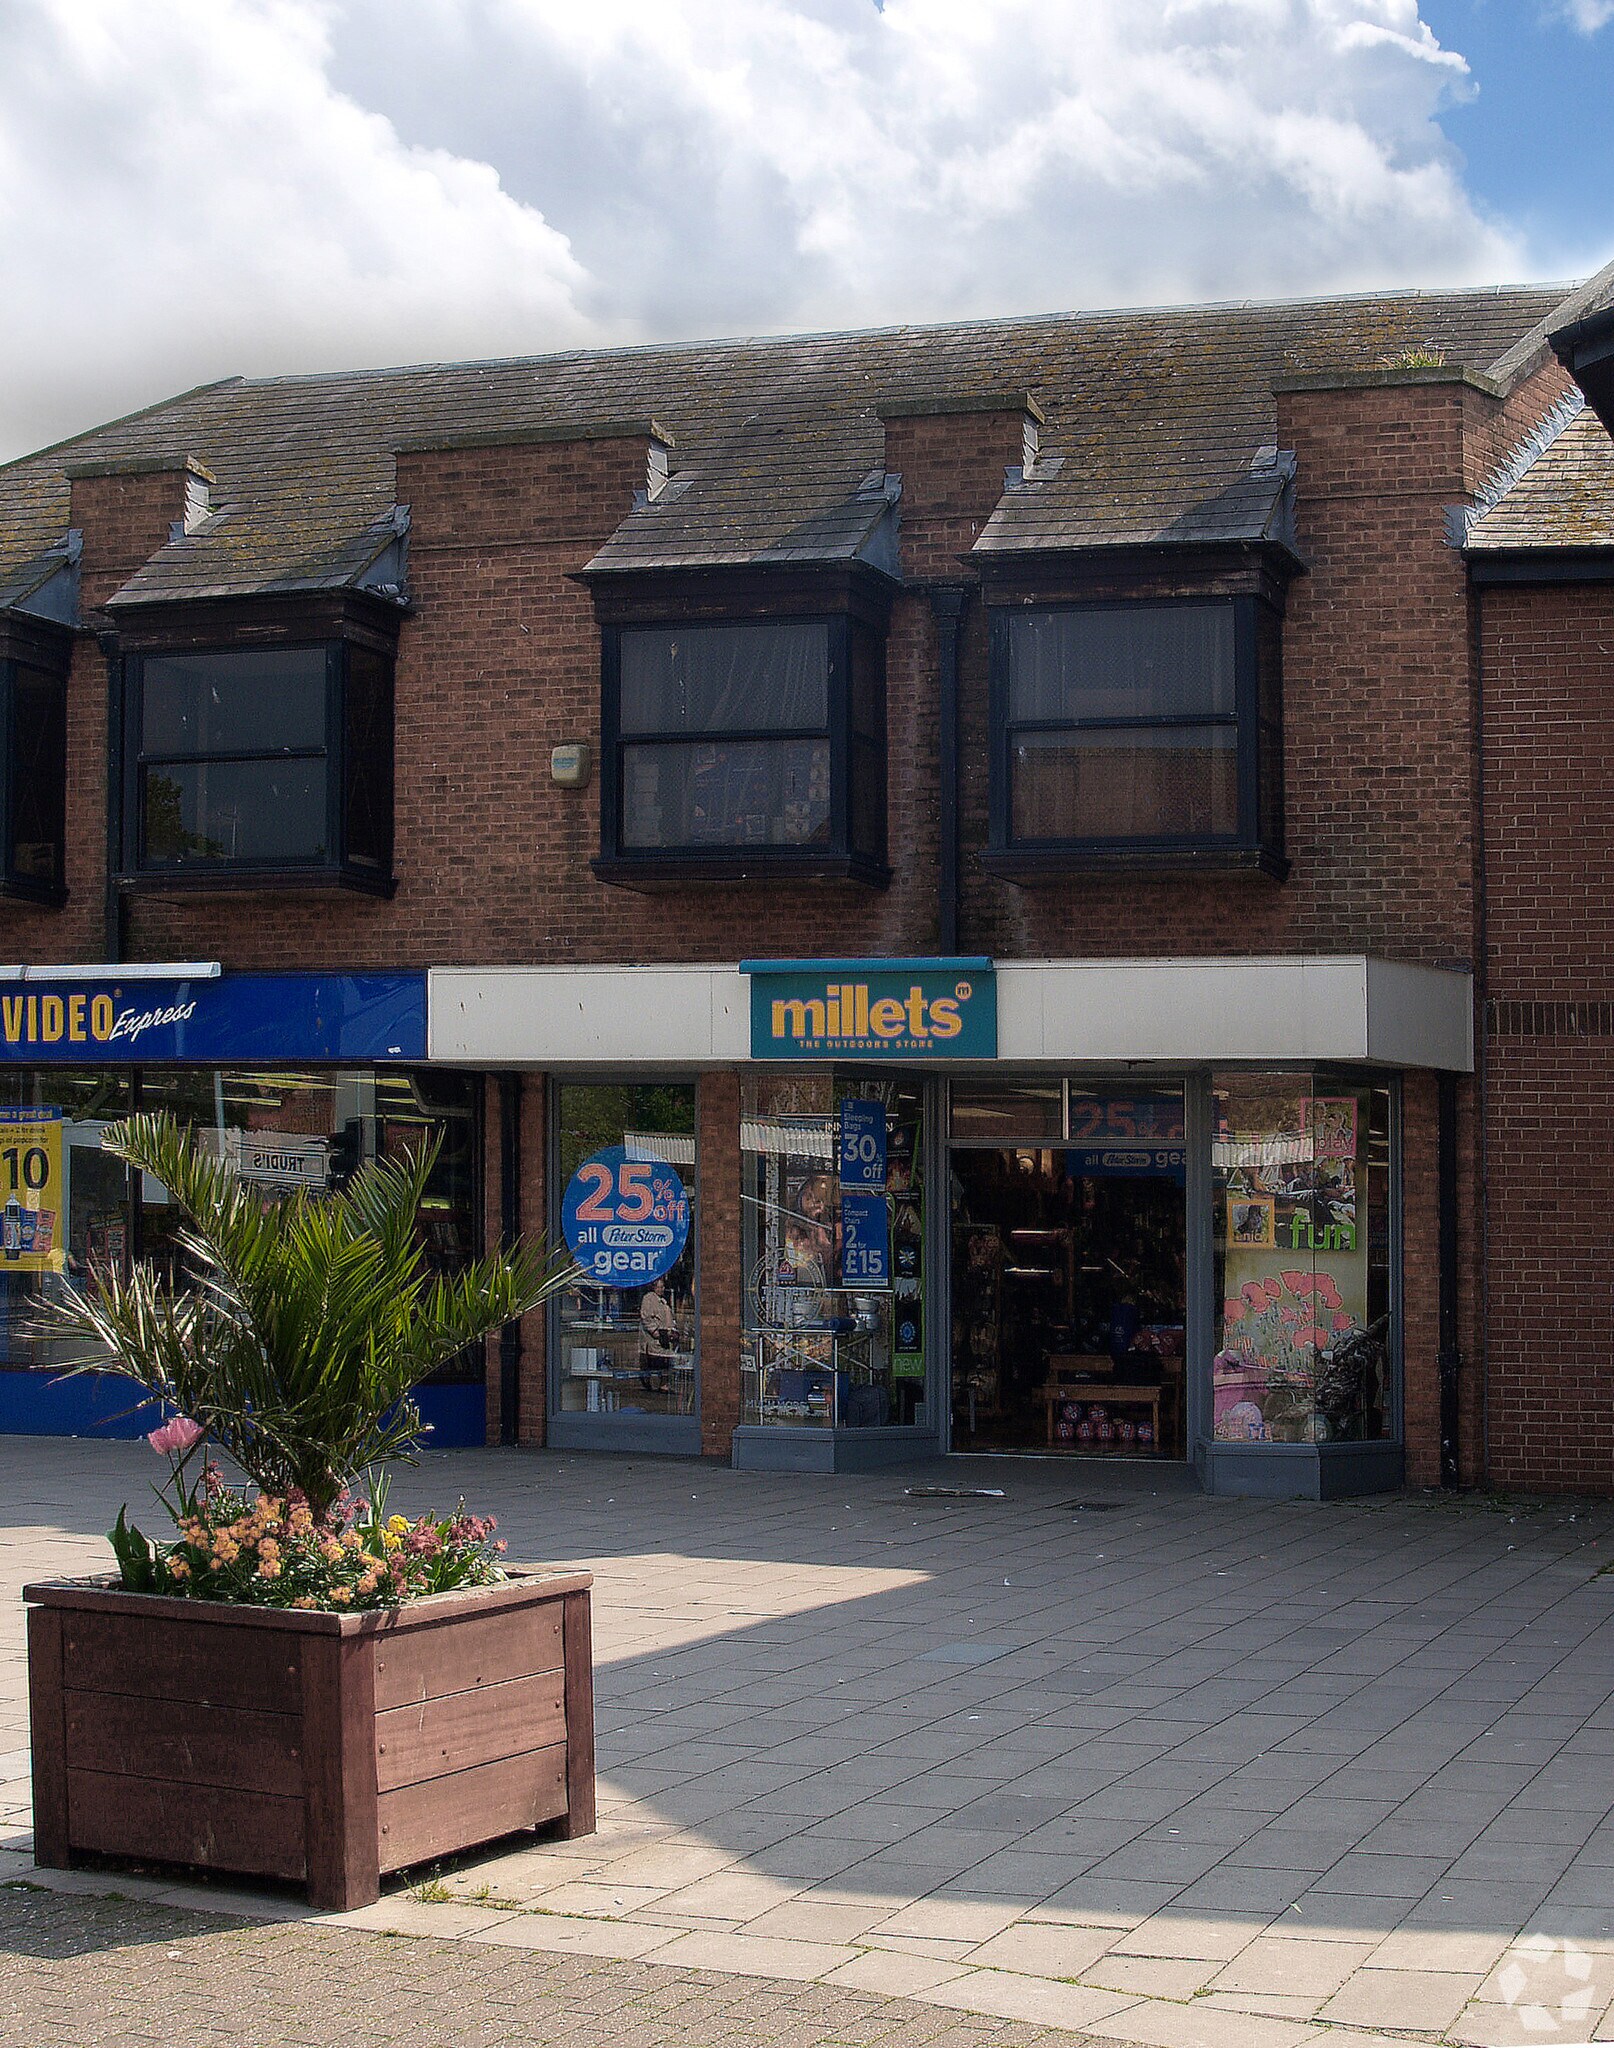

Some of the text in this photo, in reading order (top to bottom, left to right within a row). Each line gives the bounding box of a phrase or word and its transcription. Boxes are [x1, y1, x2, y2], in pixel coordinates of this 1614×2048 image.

[2, 995, 197, 1042] VIDEO Express
[772, 984, 963, 1038] millets
[799, 1040, 820, 1048] THE
[896, 1040, 933, 1048] STORE
[863, 1163, 883, 1179] off
[653, 1200, 685, 1221] off
[578, 1227, 598, 1243] all
[1290, 1214, 1356, 1250] fun
[846, 1249, 883, 1274] £15
